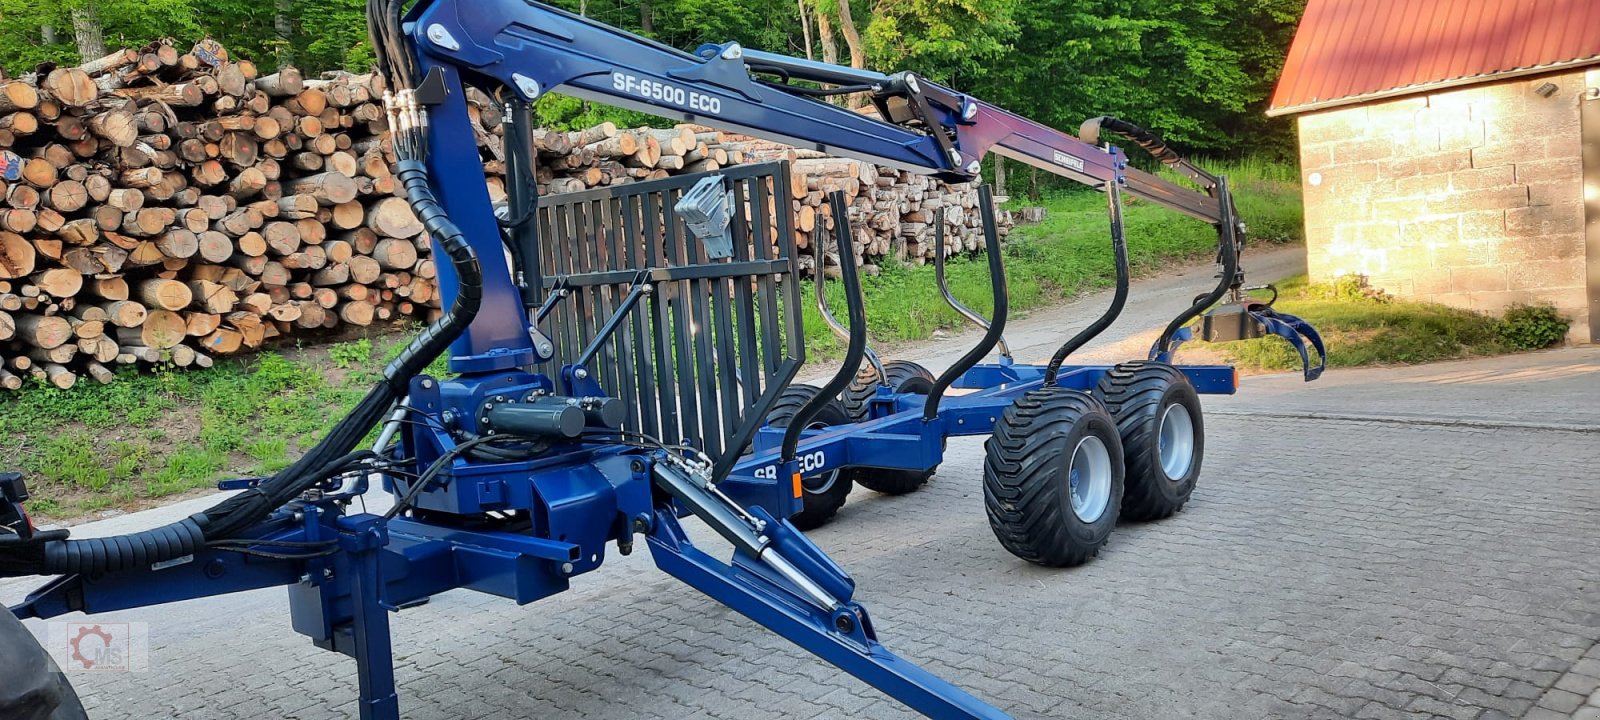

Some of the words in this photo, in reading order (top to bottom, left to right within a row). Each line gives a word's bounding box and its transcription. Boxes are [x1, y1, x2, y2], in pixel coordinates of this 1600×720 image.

[613, 72, 685, 105] SF-6500
[689, 92, 721, 114] ECO
[797, 450, 825, 474] ECO
